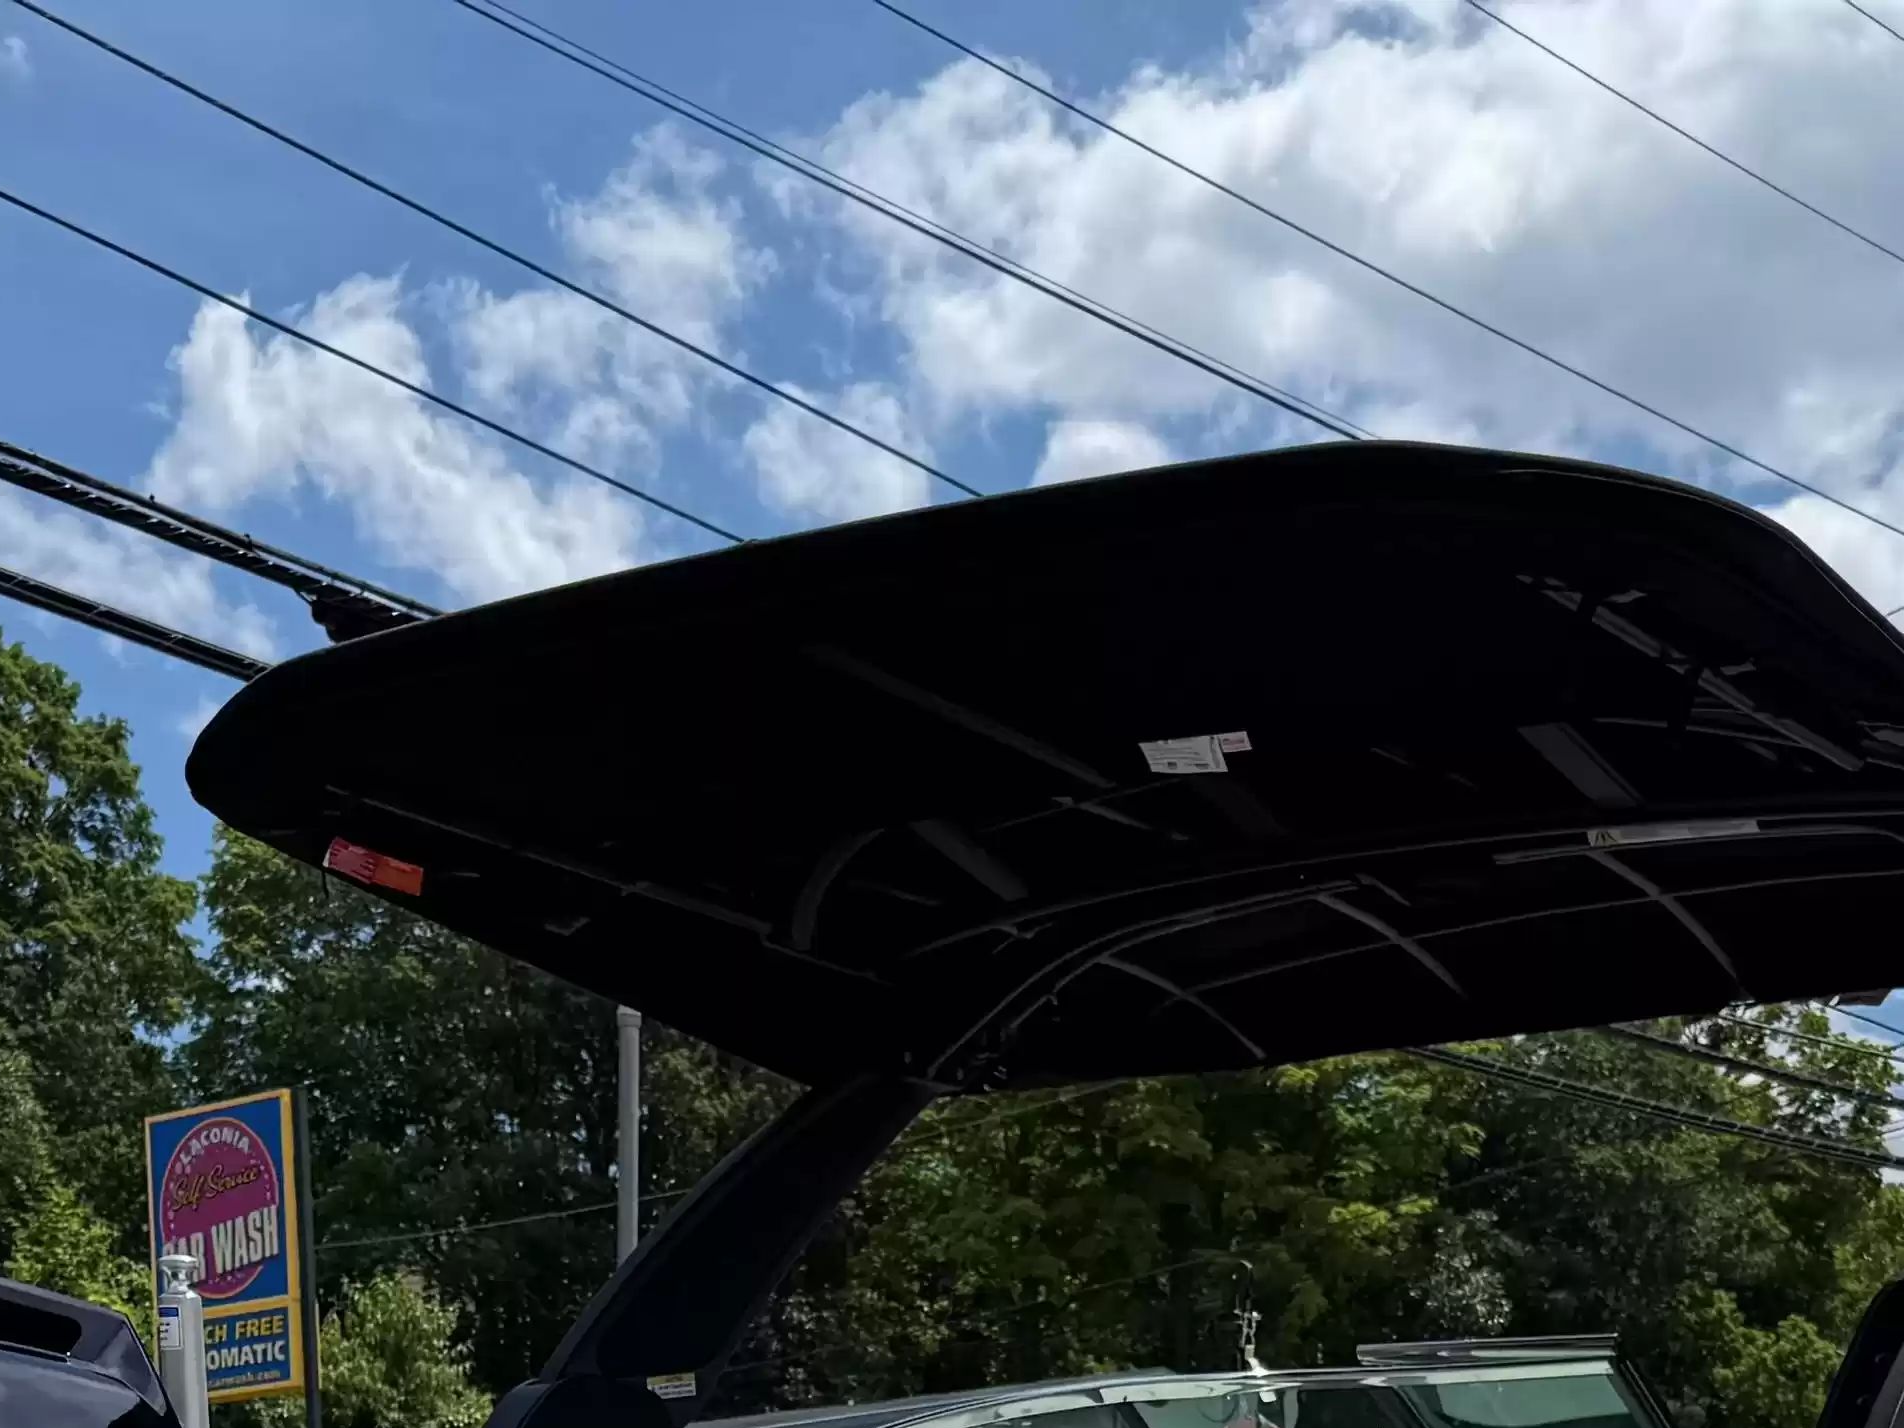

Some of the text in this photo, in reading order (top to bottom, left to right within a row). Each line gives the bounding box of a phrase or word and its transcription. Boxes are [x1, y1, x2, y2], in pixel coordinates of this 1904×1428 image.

[180, 1127, 251, 1164] LACONIA
[211, 1204, 279, 1274] WASH
[235, 1315, 285, 1341] FREE
[207, 1340, 286, 1370] OMATIC
